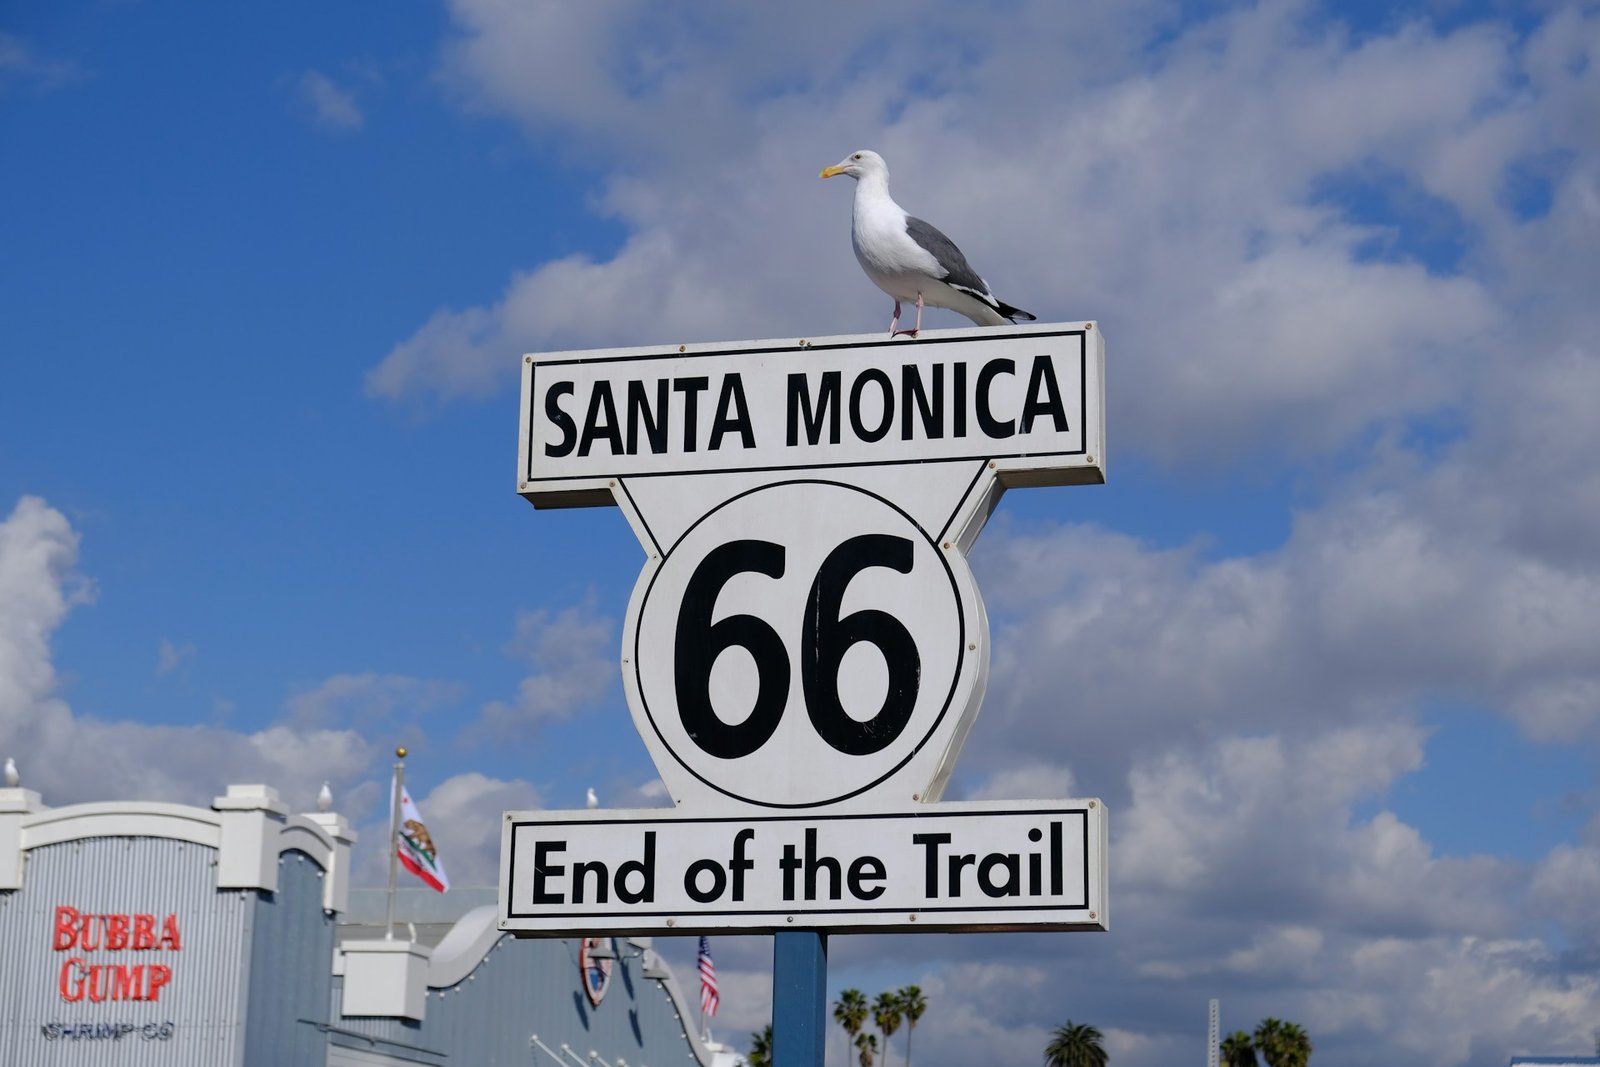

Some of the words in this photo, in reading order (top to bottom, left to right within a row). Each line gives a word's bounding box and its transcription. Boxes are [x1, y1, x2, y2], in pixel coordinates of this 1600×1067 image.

[545, 371, 756, 459] SANTA
[787, 355, 1069, 446] MONICA
[674, 534, 921, 759] 66
[533, 832, 656, 904] End
[684, 829, 754, 903] of
[779, 828, 887, 901] the
[913, 822, 1063, 898] Trail
[53, 906, 182, 952] BUBBA
[59, 957, 173, 1003] GUMP
